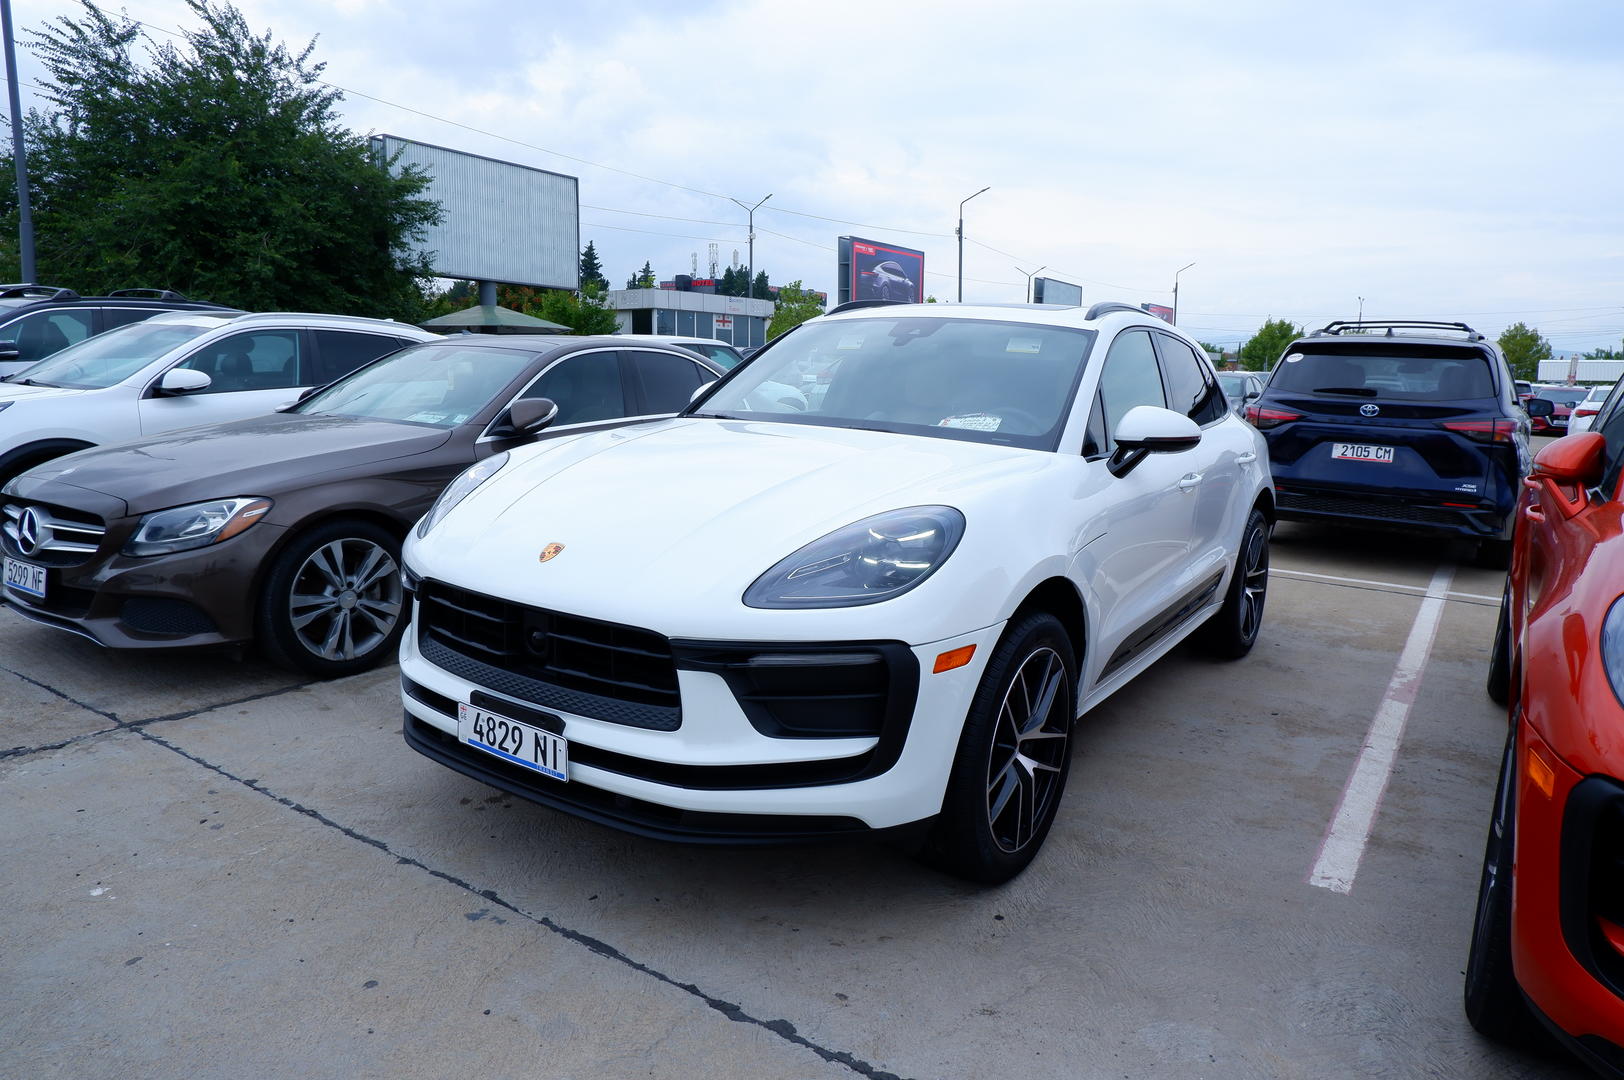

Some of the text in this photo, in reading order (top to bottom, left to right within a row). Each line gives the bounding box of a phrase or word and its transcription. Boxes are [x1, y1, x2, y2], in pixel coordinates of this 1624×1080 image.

[1341, 445, 1392, 460] 2105 CM
[8, 560, 44, 591] 5299 NF
[473, 712, 558, 771] 4829 NI
